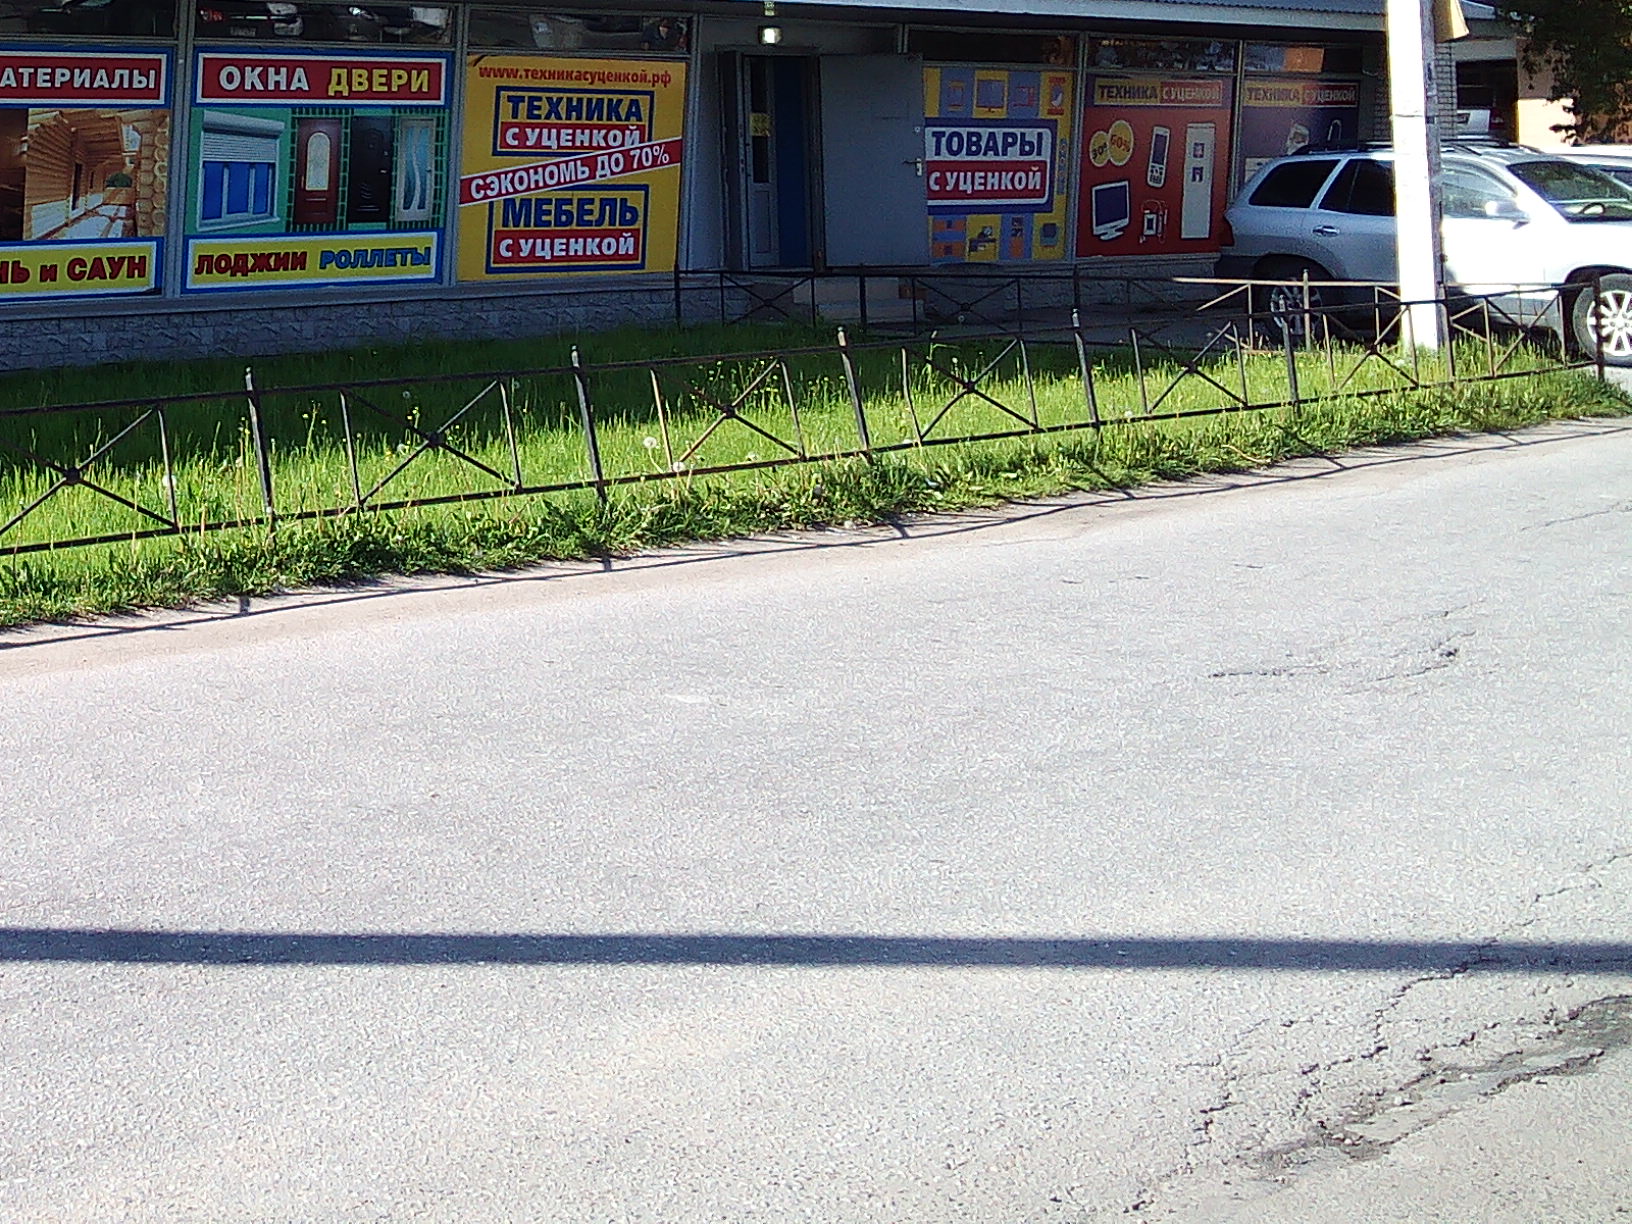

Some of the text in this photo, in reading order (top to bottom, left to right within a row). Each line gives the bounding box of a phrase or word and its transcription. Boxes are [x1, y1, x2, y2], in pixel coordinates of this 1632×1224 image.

[218, 65, 431, 97] ОКНА ДВЕРИ
[478, 65, 672, 87] www.техникасуценкой.рф
[1098, 84, 1158, 99] ТЕХНИКА
[506, 95, 643, 122] ТЕХНИКА
[505, 126, 640, 150] С УЦЕНКОЙ
[931, 131, 1044, 157] ТОВАРЫ
[470, 145, 670, 200] СЭКОНОМЬ ДО 70%
[929, 171, 941, 190] С
[945, 165, 1041, 194] УЦЕНКОЙ
[501, 197, 639, 228] МЕБЕЛЬ
[499, 233, 635, 259] С УЦЕНКОЙ
[39, 266, 58, 283] и
[66, 255, 148, 281] САУН
[194, 246, 432, 276] ЛОДЖИИ РОЛЛЕТЫ
